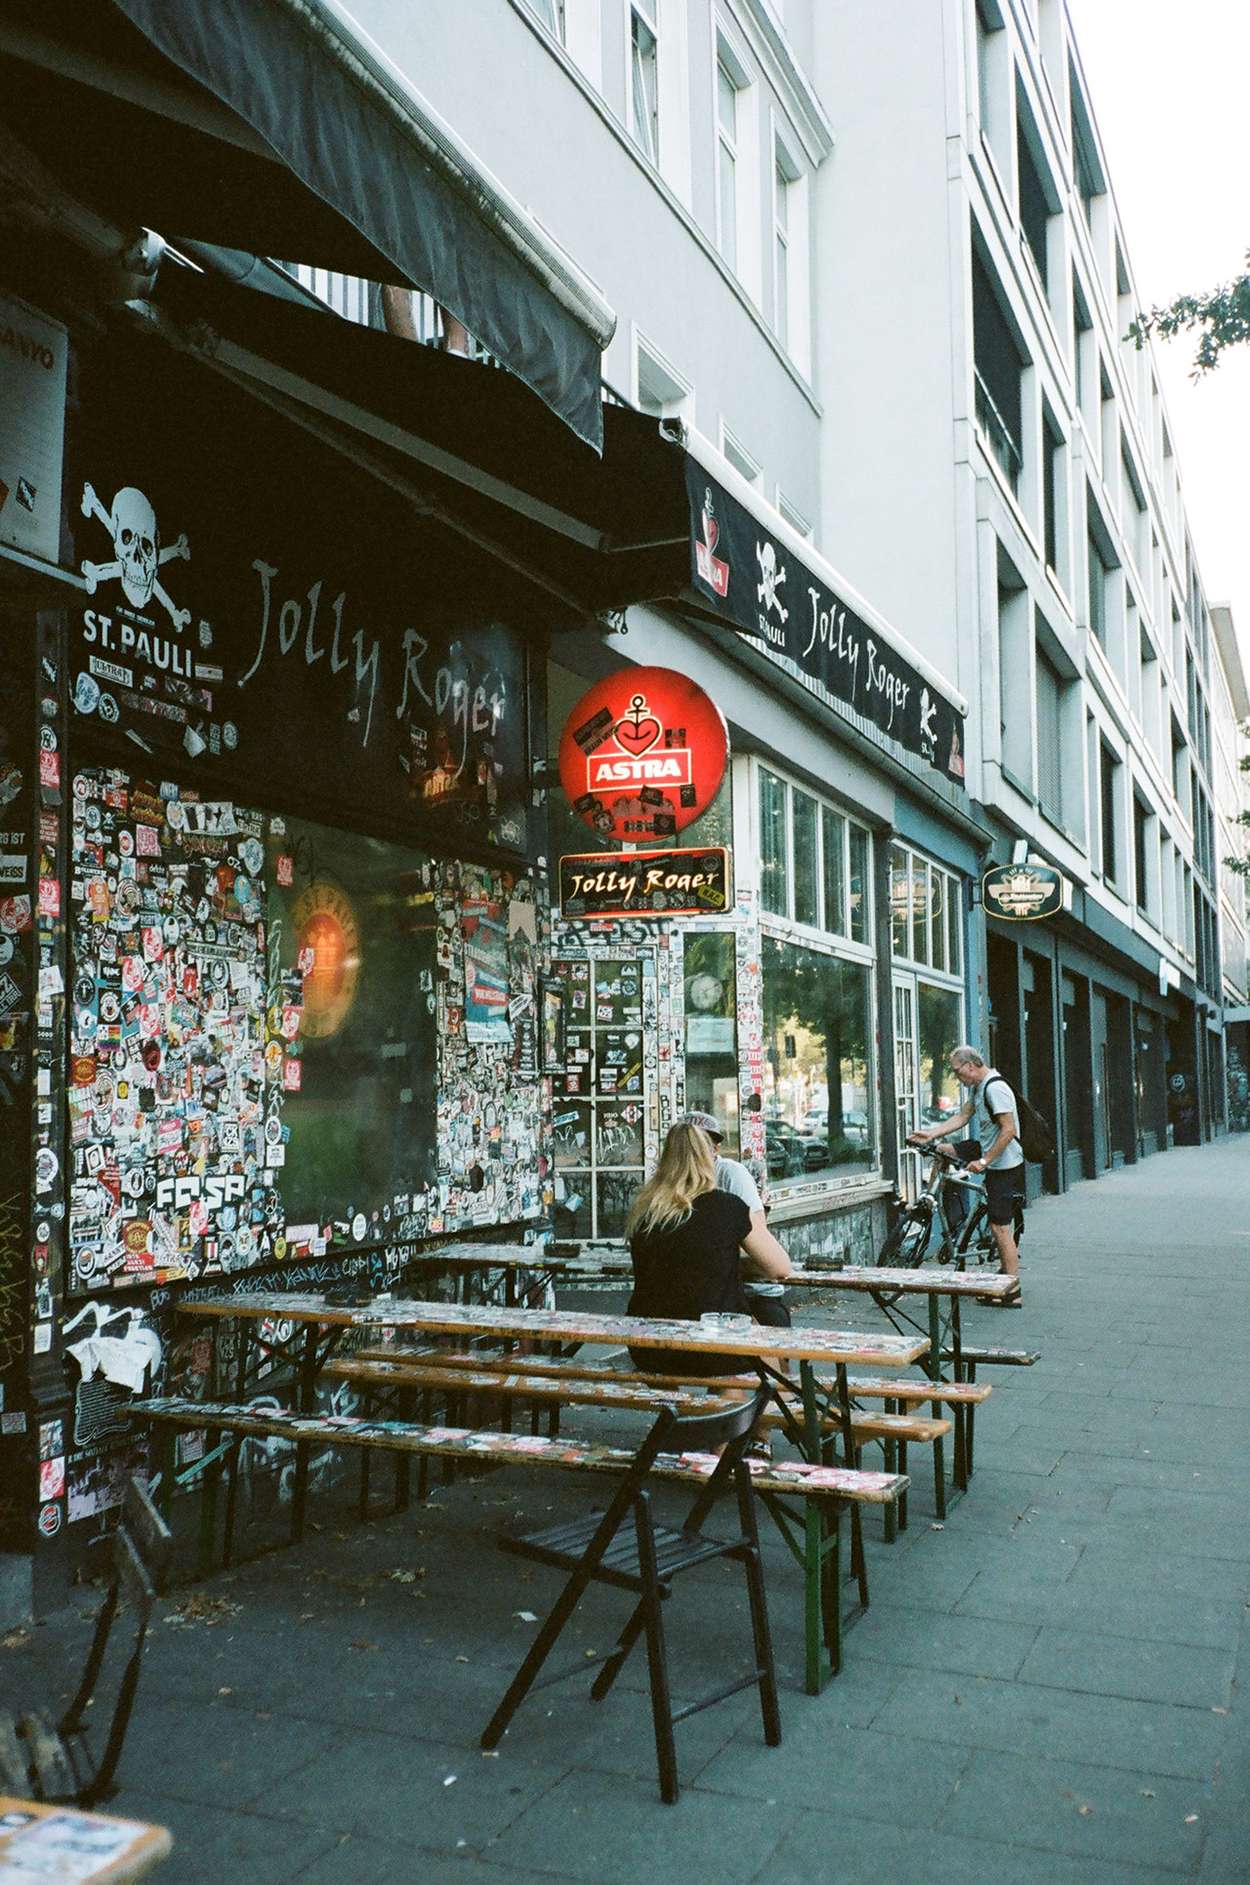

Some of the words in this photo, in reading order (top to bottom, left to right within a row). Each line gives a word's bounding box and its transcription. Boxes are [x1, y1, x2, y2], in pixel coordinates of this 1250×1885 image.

[0, 326, 54, 370] ANYO
[120, 623, 192, 678] PAULI
[237, 559, 380, 748] Jolly
[396, 627, 508, 781] Roger
[802, 586, 860, 702] Jolly
[864, 639, 911, 731] Roger
[595, 758, 682, 782] ASTRA
[570, 871, 637, 903] Jolly
[643, 869, 720, 894] Roger
